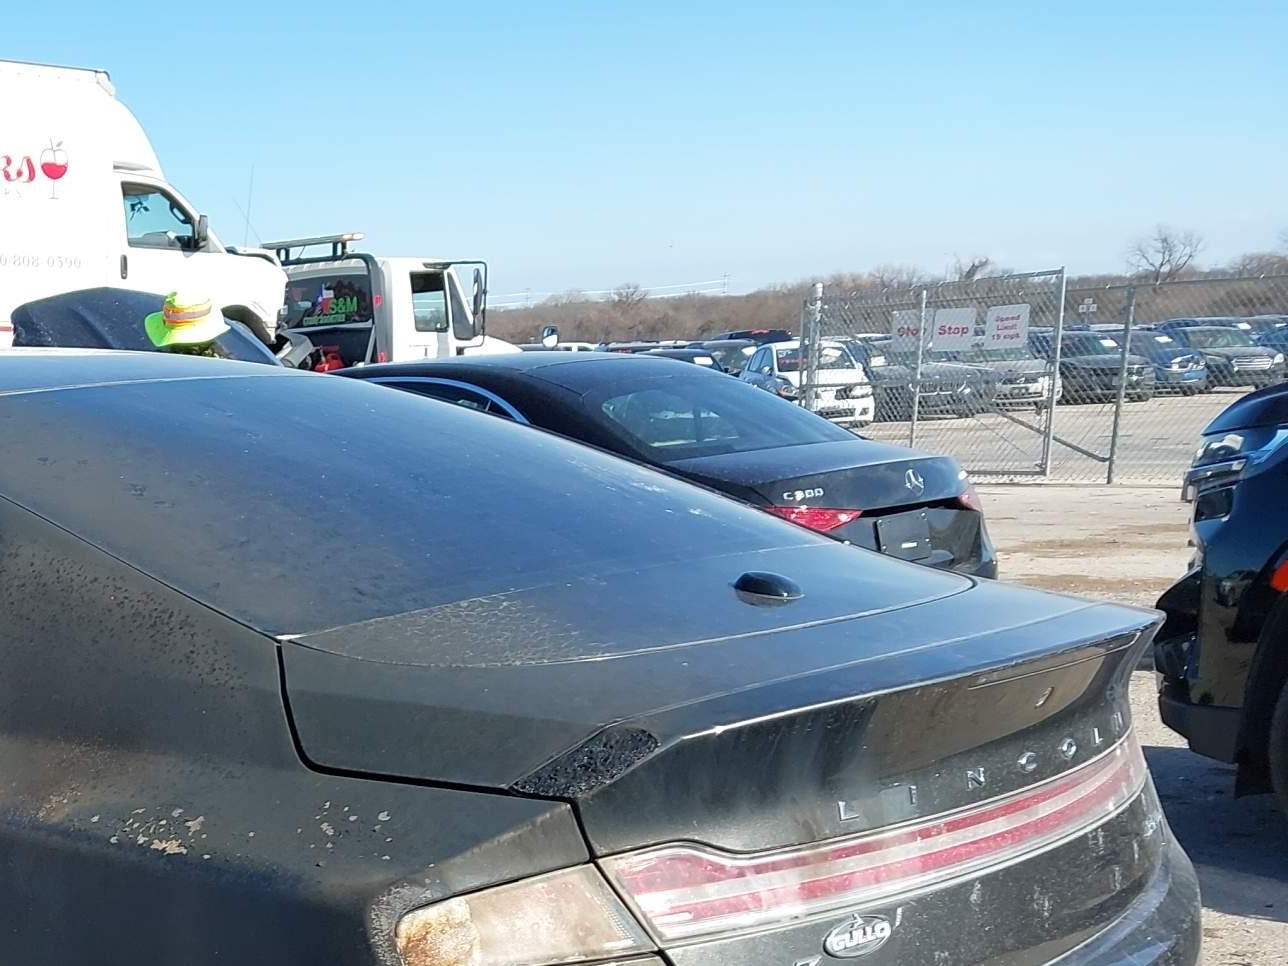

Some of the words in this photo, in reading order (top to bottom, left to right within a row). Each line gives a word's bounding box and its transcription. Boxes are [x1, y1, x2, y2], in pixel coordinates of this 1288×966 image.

[329, 296, 358, 314] S&M
[938, 325, 969, 337] Stop
[831, 920, 892, 952] GULLO
